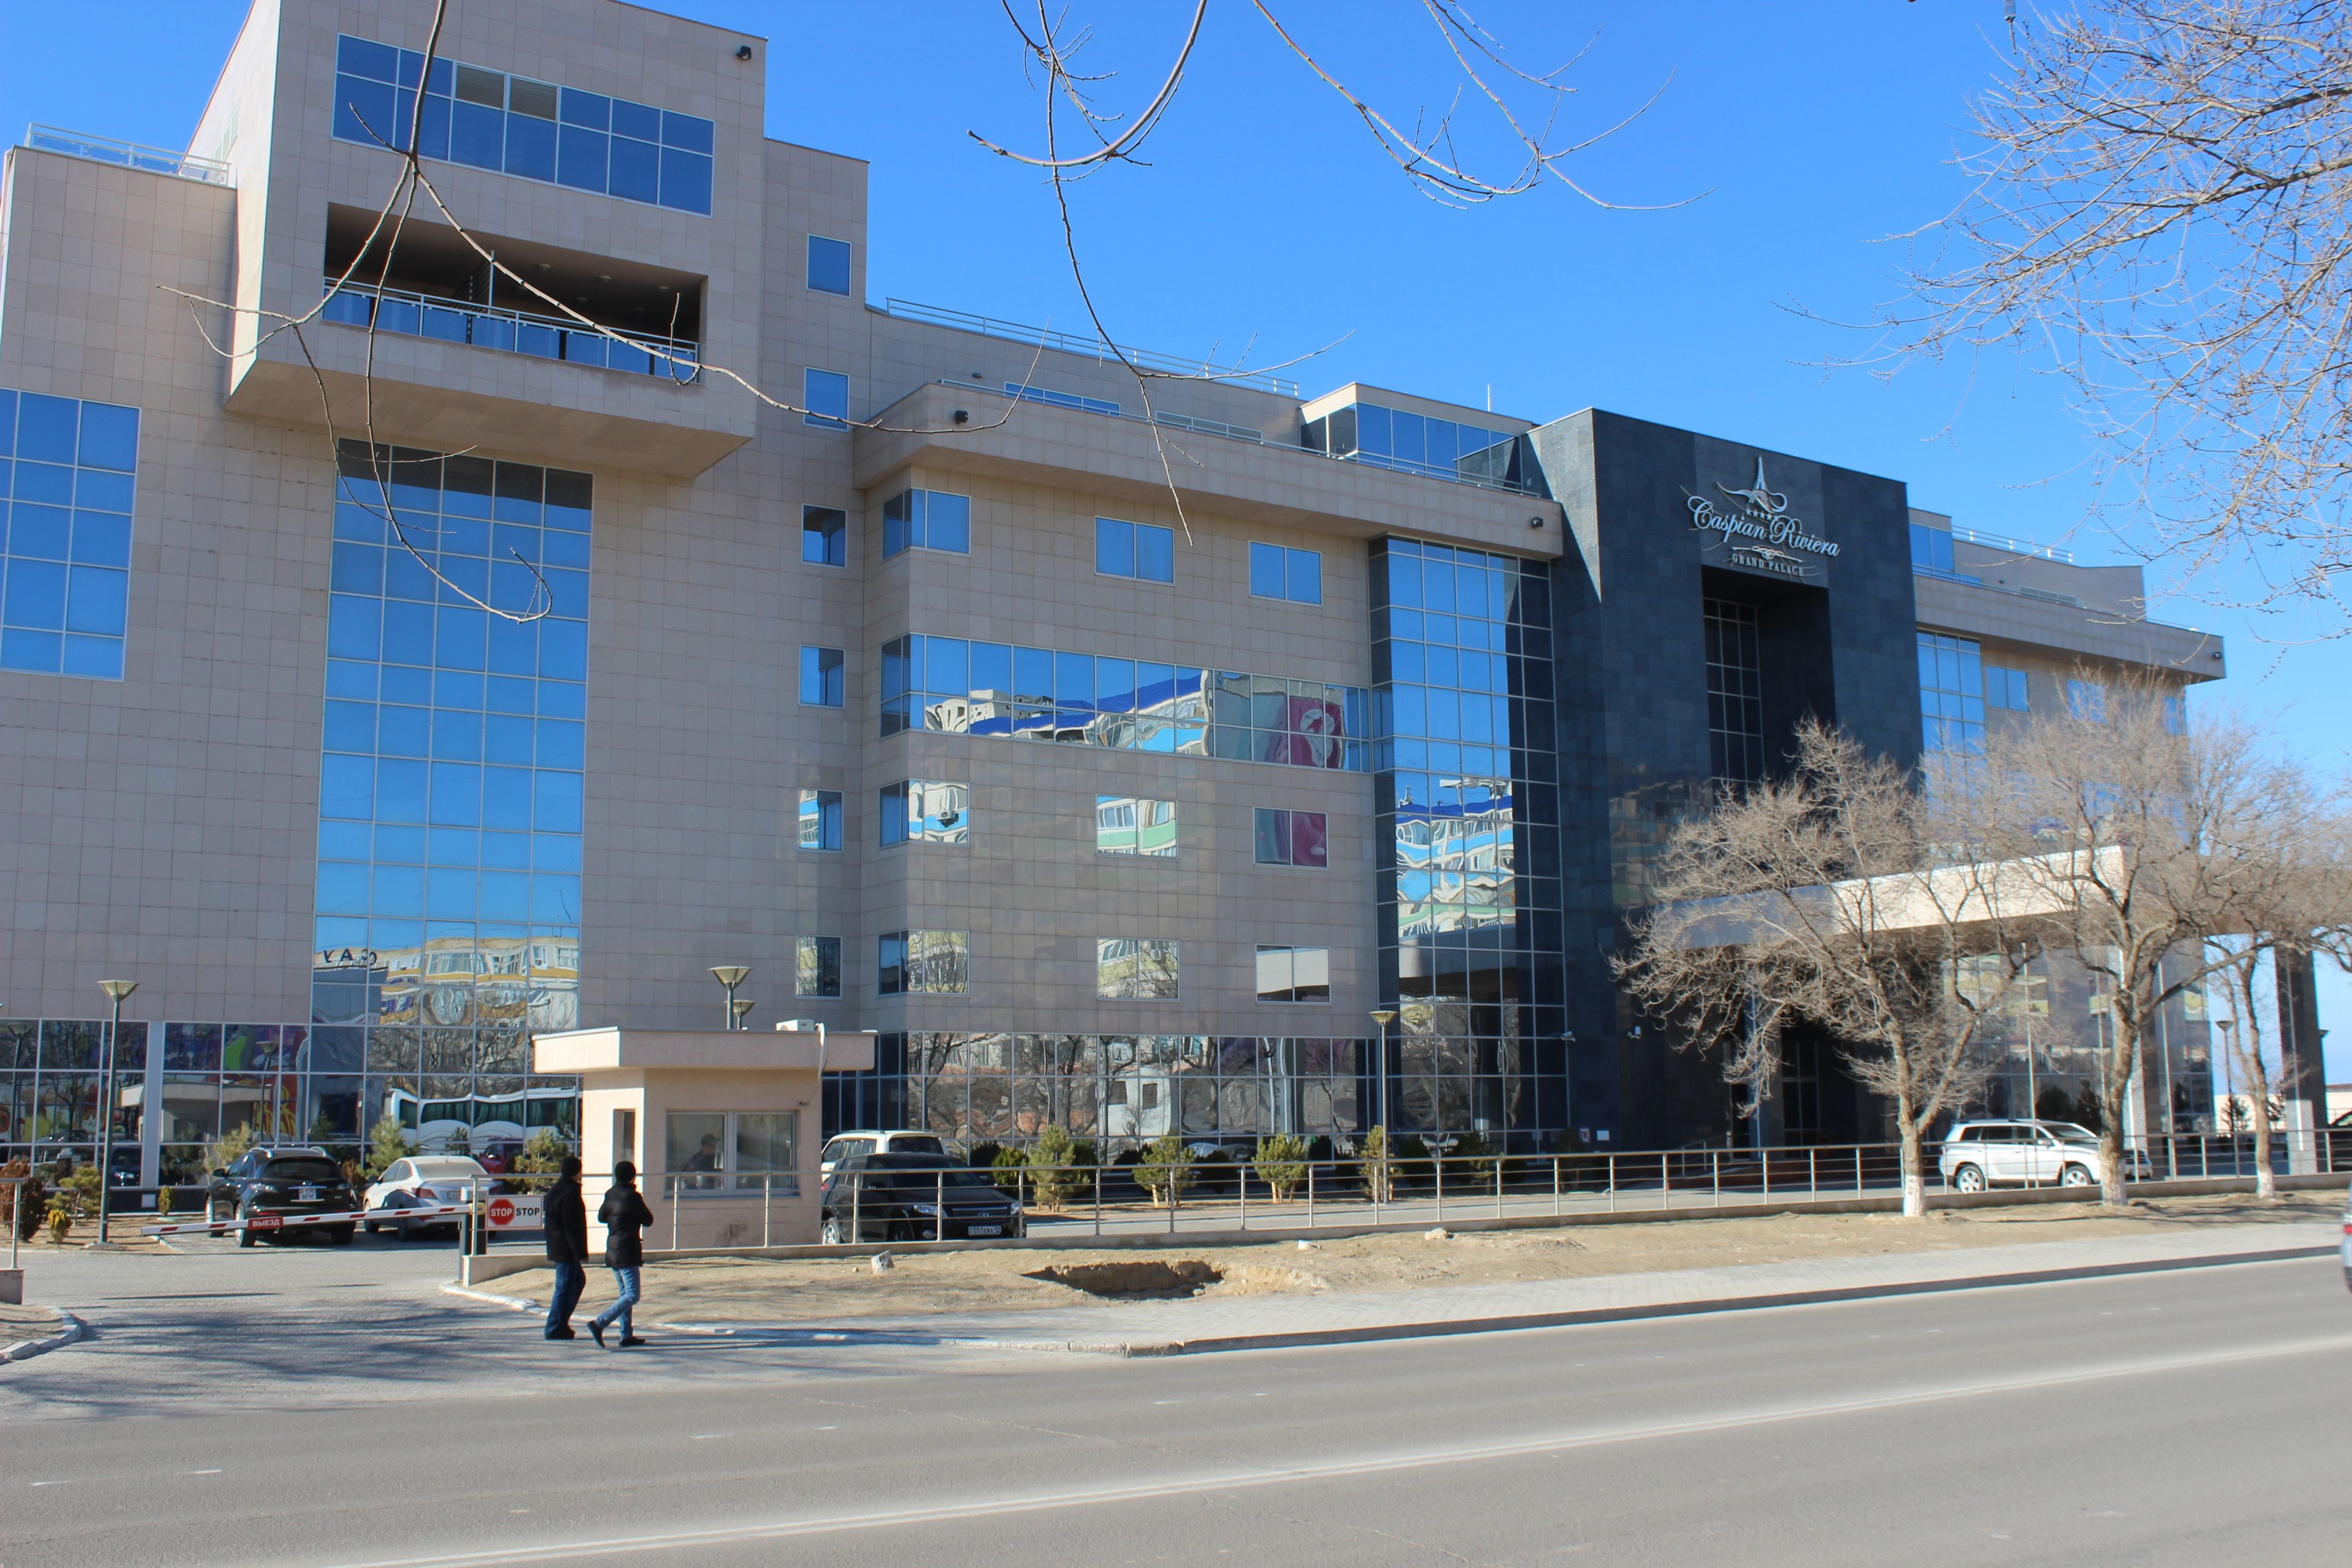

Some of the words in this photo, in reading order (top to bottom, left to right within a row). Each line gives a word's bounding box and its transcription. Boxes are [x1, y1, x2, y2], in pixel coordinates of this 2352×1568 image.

[1688, 496, 1766, 543] Caspian
[1769, 515, 1840, 556] Riviera
[1732, 554, 1764, 568] GRAND
[1768, 561, 1804, 576] PALACE
[491, 1208, 512, 1216] STOP
[252, 1219, 280, 1227] ВЫЕЗД
